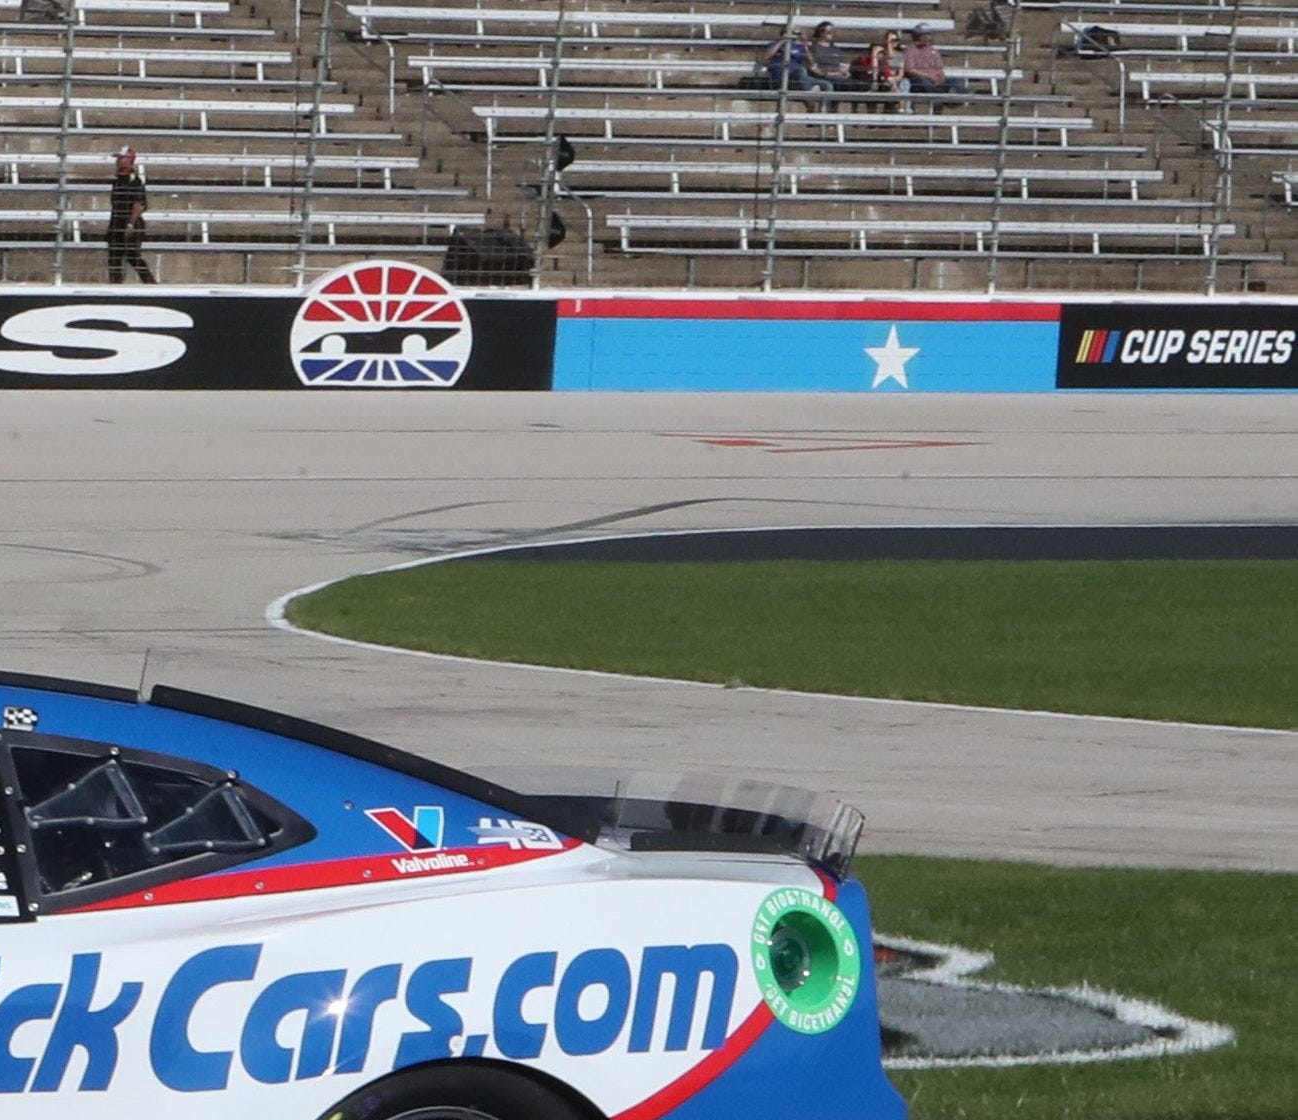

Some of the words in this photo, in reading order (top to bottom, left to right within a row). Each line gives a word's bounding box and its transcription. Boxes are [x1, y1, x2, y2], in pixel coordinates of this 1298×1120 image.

[1121, 330, 1186, 363] CUP
[1186, 330, 1297, 363] SERIES
[390, 853, 470, 873] Valvoline
